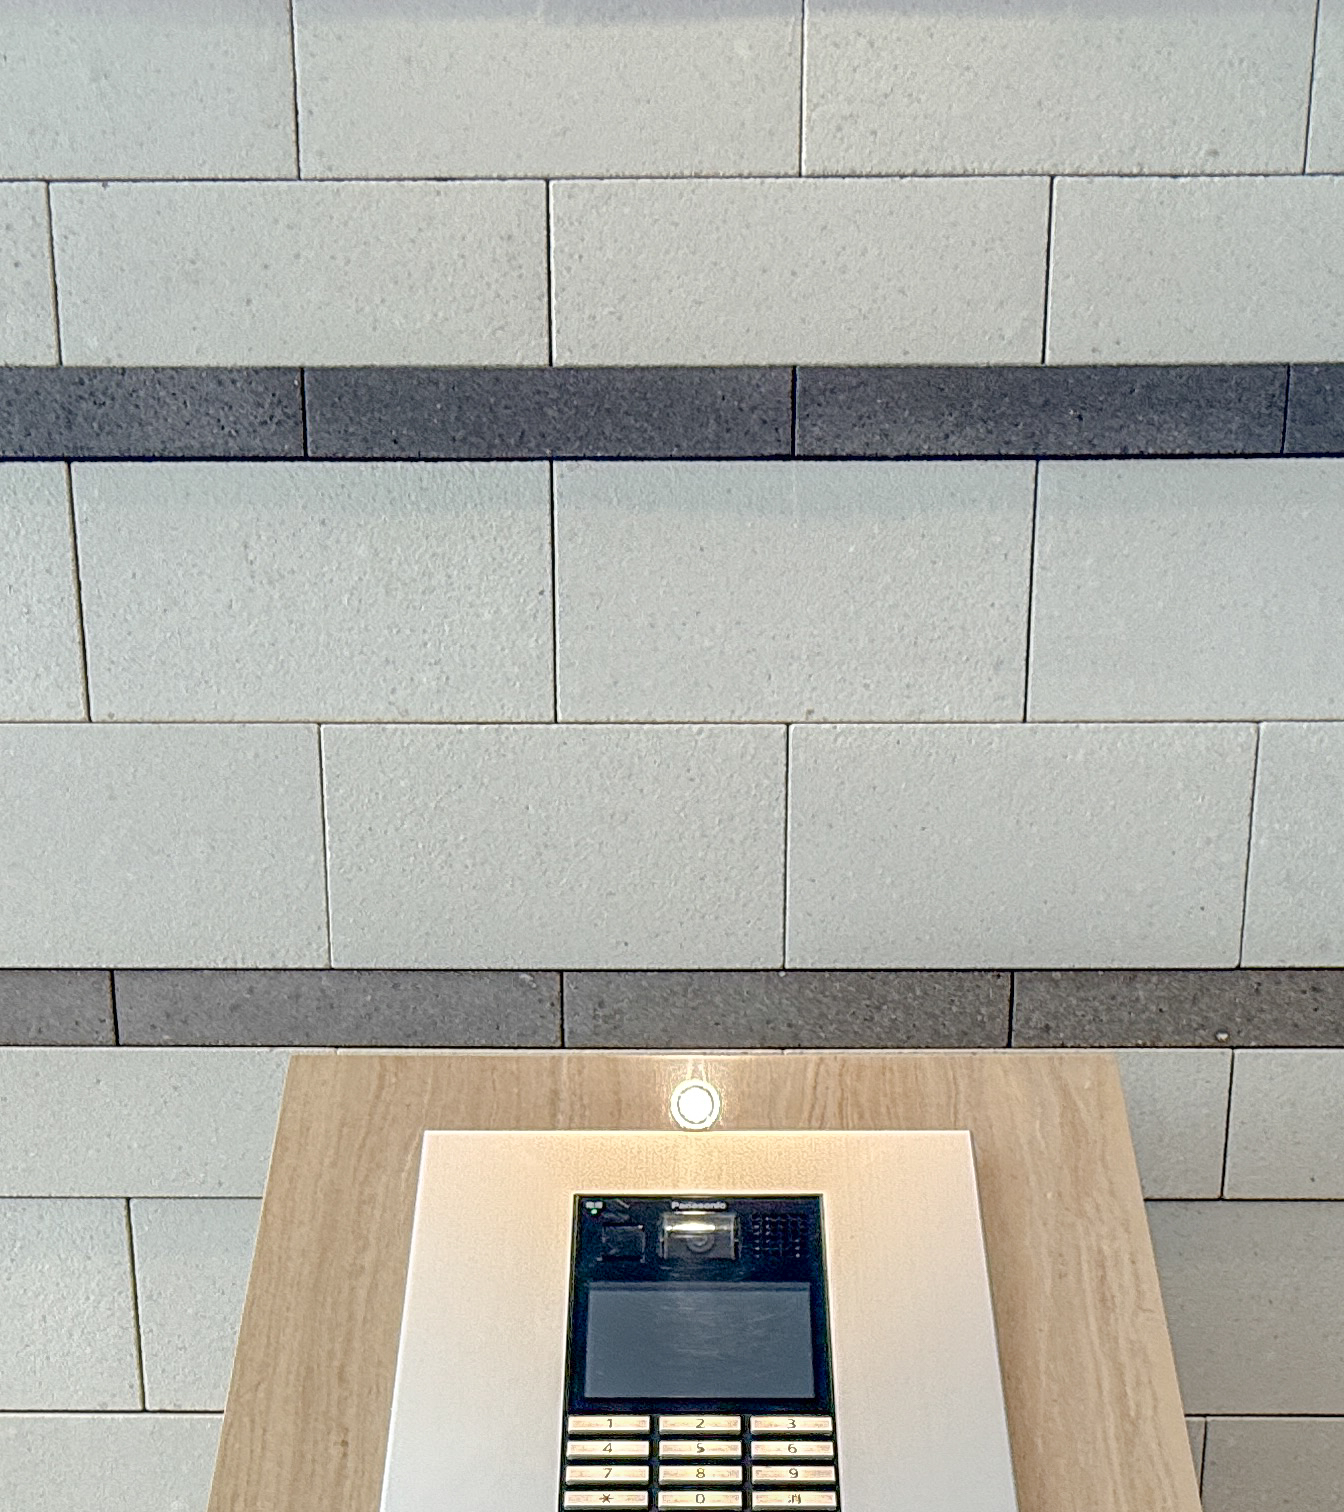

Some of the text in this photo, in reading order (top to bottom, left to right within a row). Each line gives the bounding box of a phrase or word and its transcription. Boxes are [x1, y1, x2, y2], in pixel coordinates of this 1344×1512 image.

[671, 1201, 727, 1210] Panasonic
[695, 1418, 705, 1429] 2
[787, 1418, 797, 1429] 3
[602, 1442, 613, 1453] 4
[696, 1443, 705, 1454] 5
[787, 1443, 798, 1454] 6
[604, 1468, 613, 1479] 7
[695, 1468, 706, 1479] 8
[788, 1467, 799, 1479] 9
[695, 1493, 706, 1505] 0
